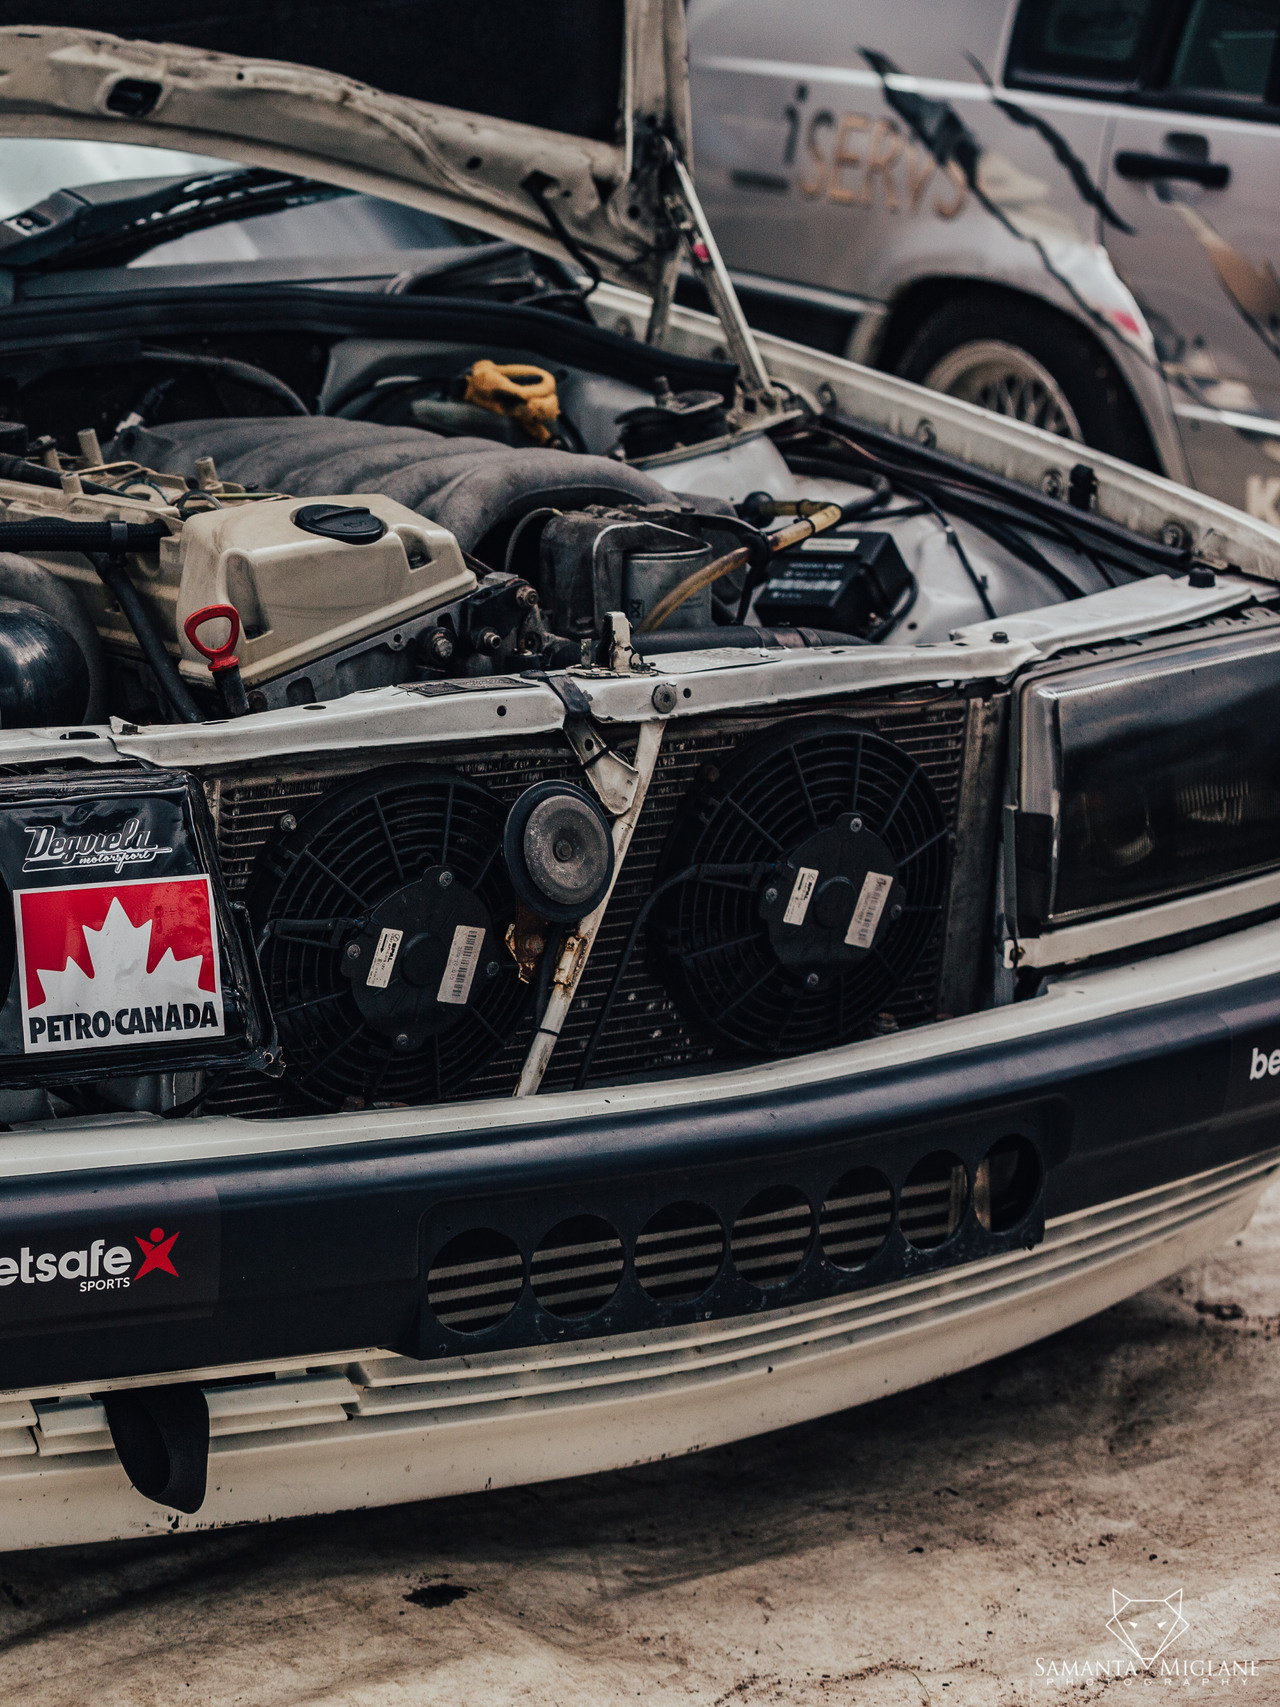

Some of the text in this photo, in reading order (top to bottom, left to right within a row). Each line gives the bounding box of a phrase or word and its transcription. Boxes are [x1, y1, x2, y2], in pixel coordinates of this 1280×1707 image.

[24, 818, 158, 864] Degviela
[78, 850, 150, 874] motorsport
[28, 1001, 219, 1044] PETRO-CANADA
[79, 1276, 131, 1293] SPORTS
